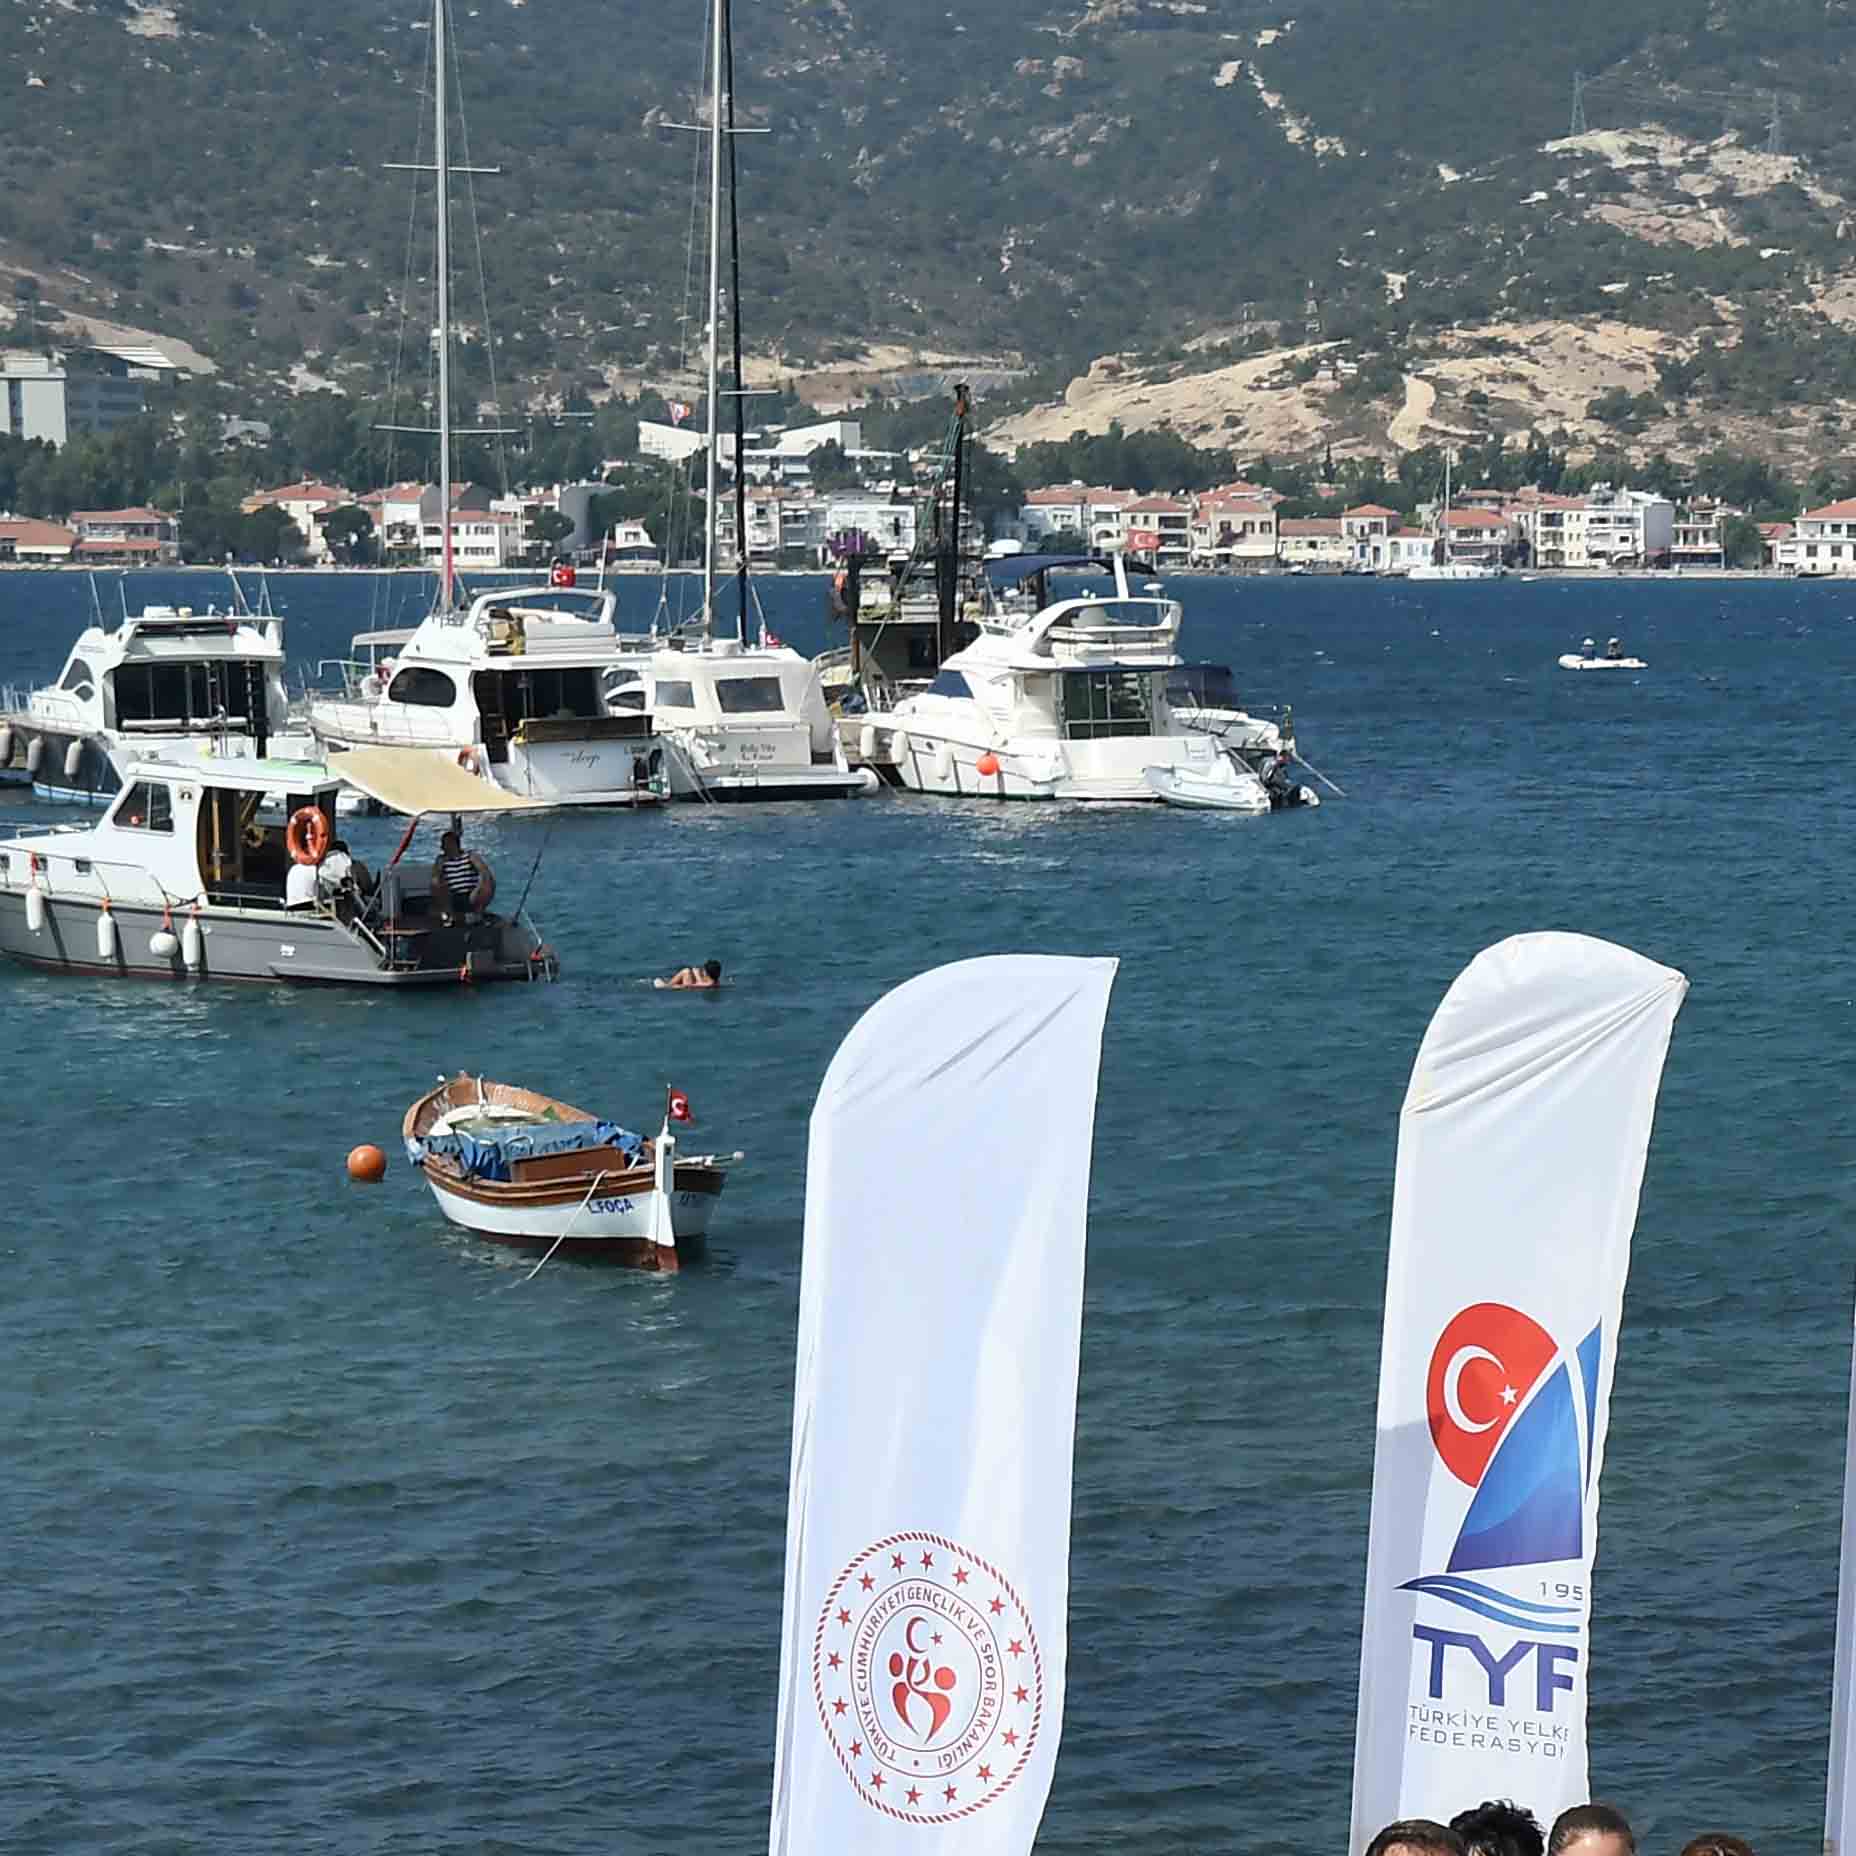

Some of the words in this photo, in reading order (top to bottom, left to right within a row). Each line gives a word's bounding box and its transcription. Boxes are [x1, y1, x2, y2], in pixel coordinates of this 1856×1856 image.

[966, 1615, 987, 1641] VE
[980, 1642, 998, 1692] SPOR
[1413, 1623, 1579, 1713] TYF
[1409, 1703, 1499, 1731] TÜRKİYE
